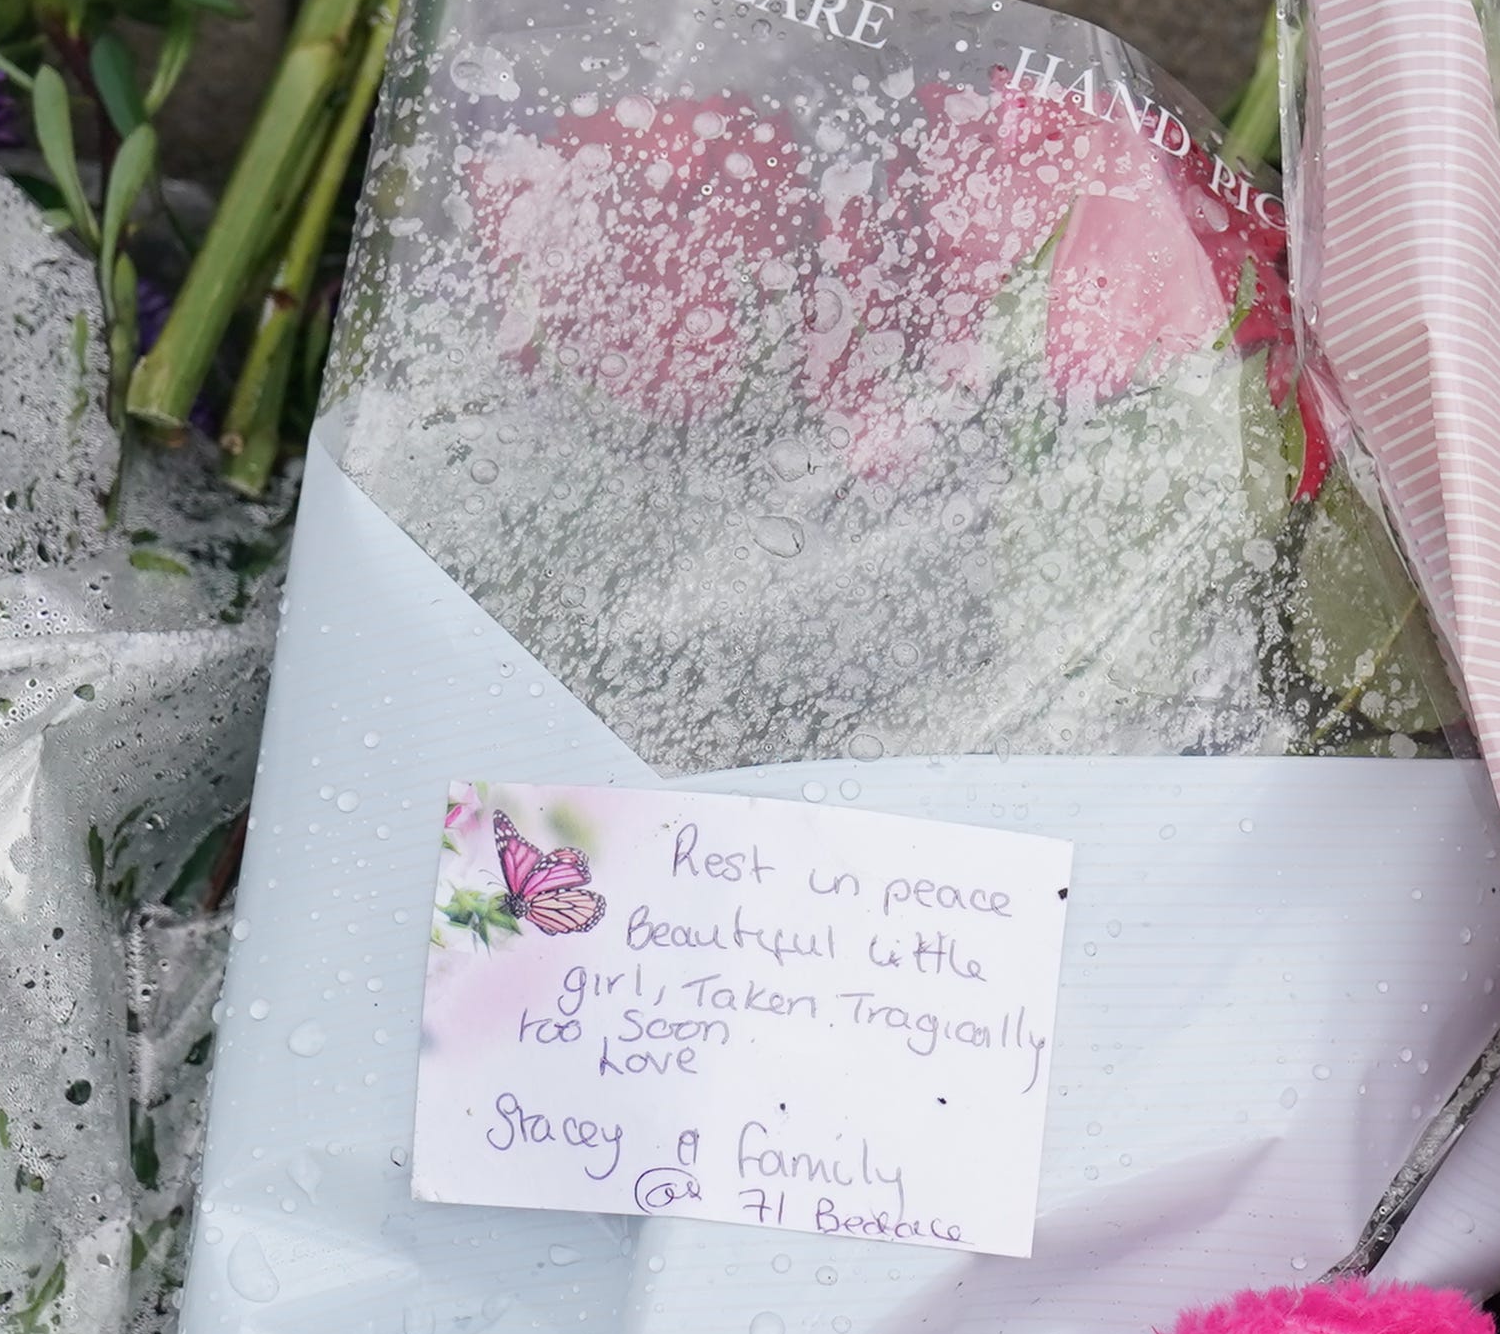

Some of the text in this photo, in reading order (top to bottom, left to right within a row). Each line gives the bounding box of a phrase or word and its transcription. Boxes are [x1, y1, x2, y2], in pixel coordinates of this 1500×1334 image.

[1007, 46, 1289, 232] HAND PIC
[673, 823, 776, 884] Rest
[883, 882, 1013, 918] peace
